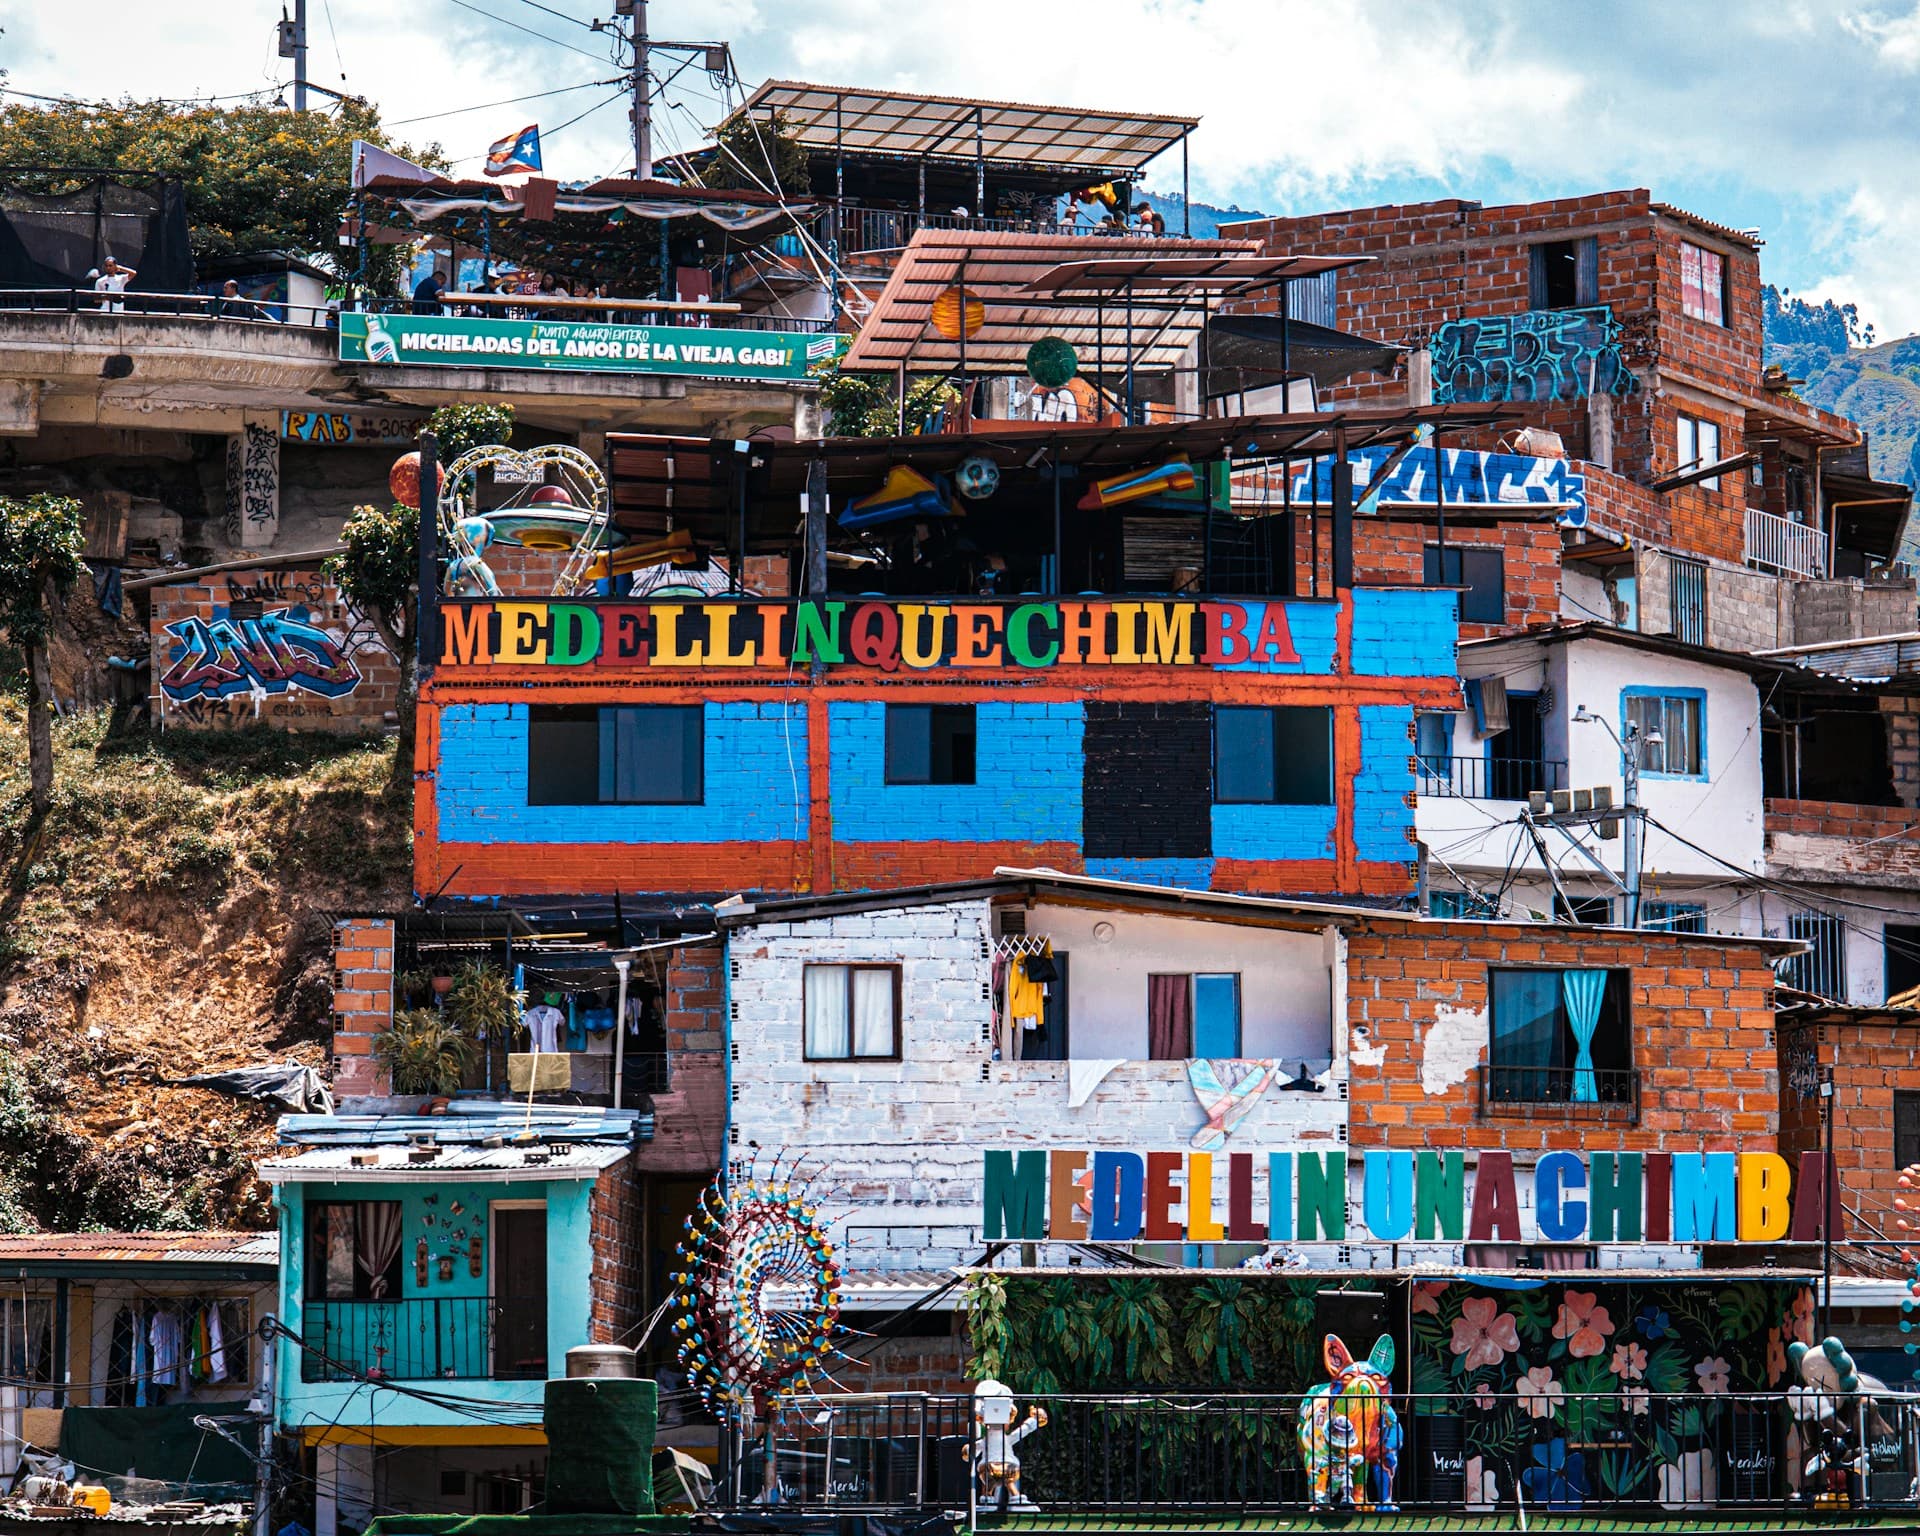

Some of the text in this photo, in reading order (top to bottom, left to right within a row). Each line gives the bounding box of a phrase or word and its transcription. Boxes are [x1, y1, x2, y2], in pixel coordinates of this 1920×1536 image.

[401, 333, 523, 354] MICHELADAS
[526, 338, 560, 355] DEL
[563, 340, 623, 358] AMOR
[625, 343, 649, 360] DE
[652, 343, 676, 361] LA
[680, 345, 735, 364] VIEJA
[737, 349, 793, 367] GABI!
[983, 1150, 1345, 1241] MEDELLIN
